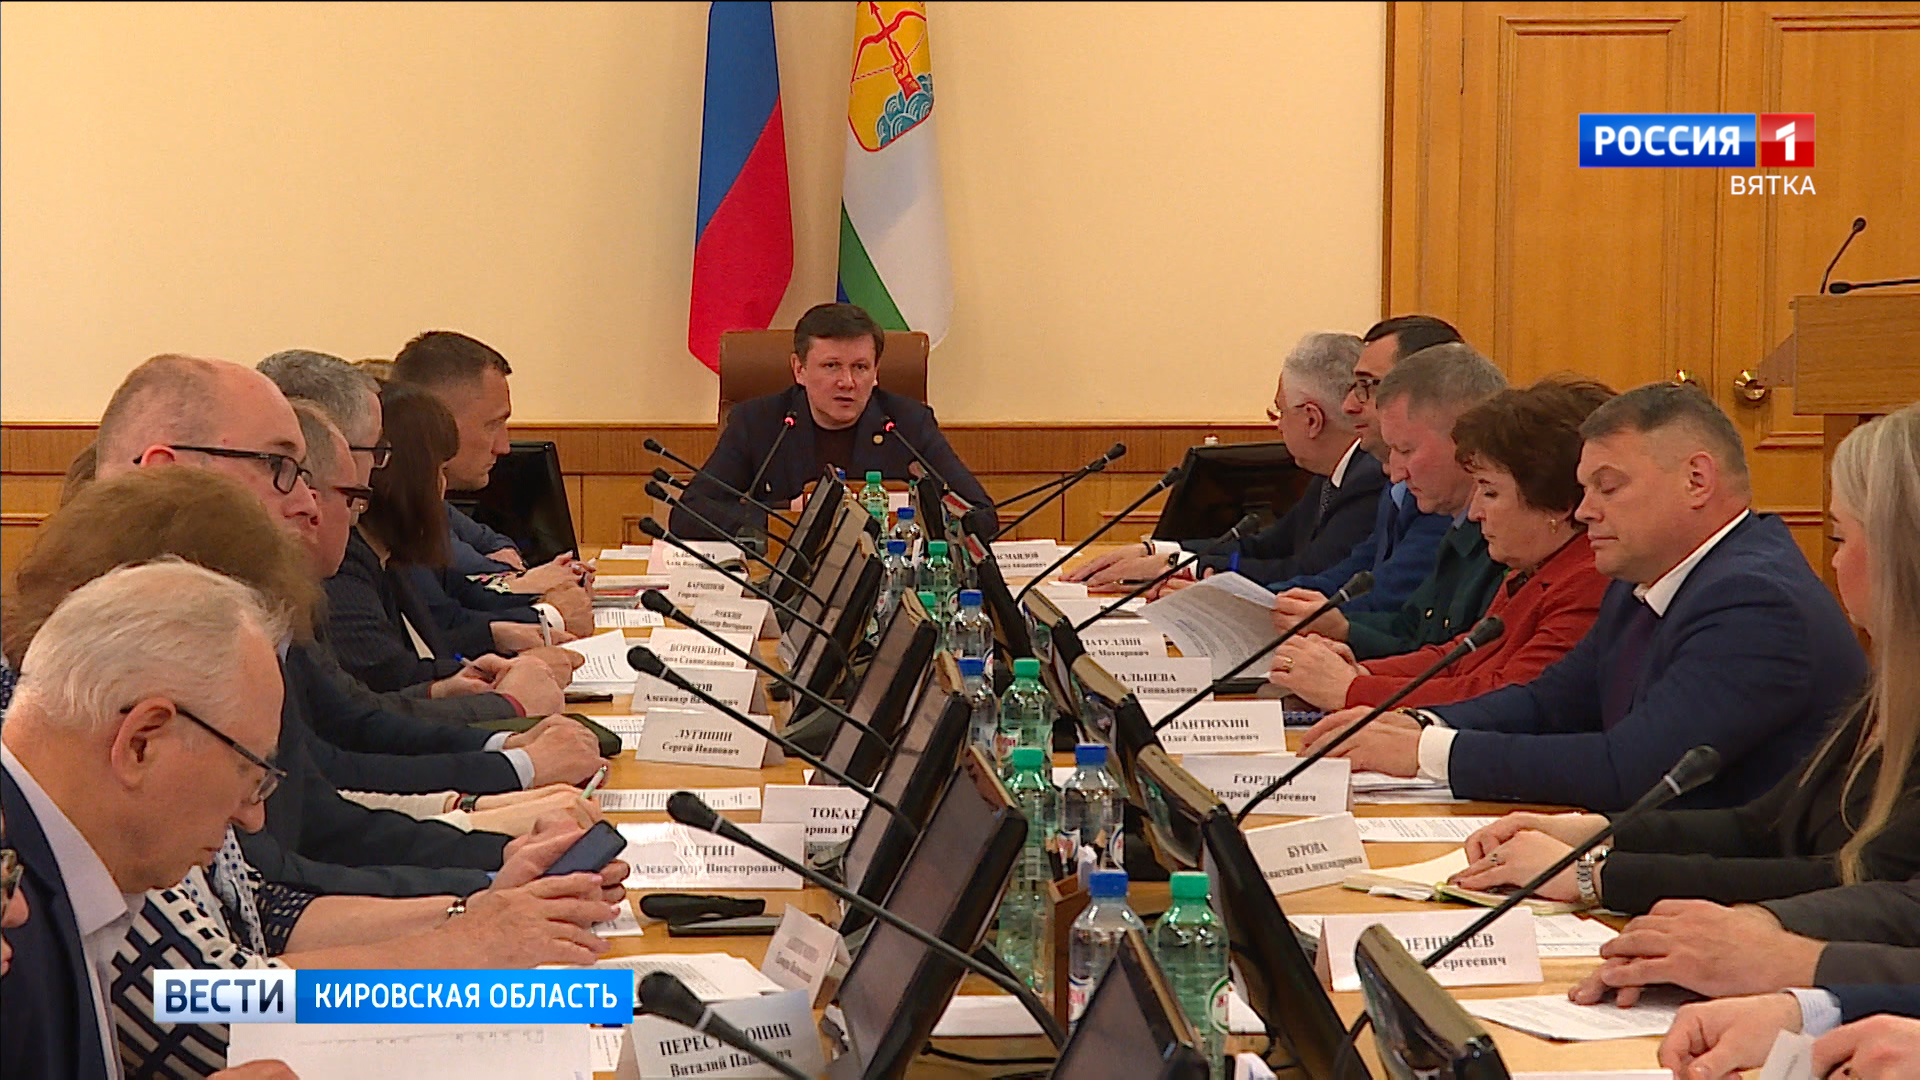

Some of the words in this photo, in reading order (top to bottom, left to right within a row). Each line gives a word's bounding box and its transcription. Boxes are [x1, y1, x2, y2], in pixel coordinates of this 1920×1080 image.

[1170, 719, 1249, 730] ПАНТЮХИН
[662, 743, 693, 755] Сергей
[1287, 842, 1328, 858] БУРОВА
[706, 863, 786, 876] Викторович
[659, 1022, 792, 1056] ПЕРЕСОНИН
[670, 1055, 727, 1077] Виталий
